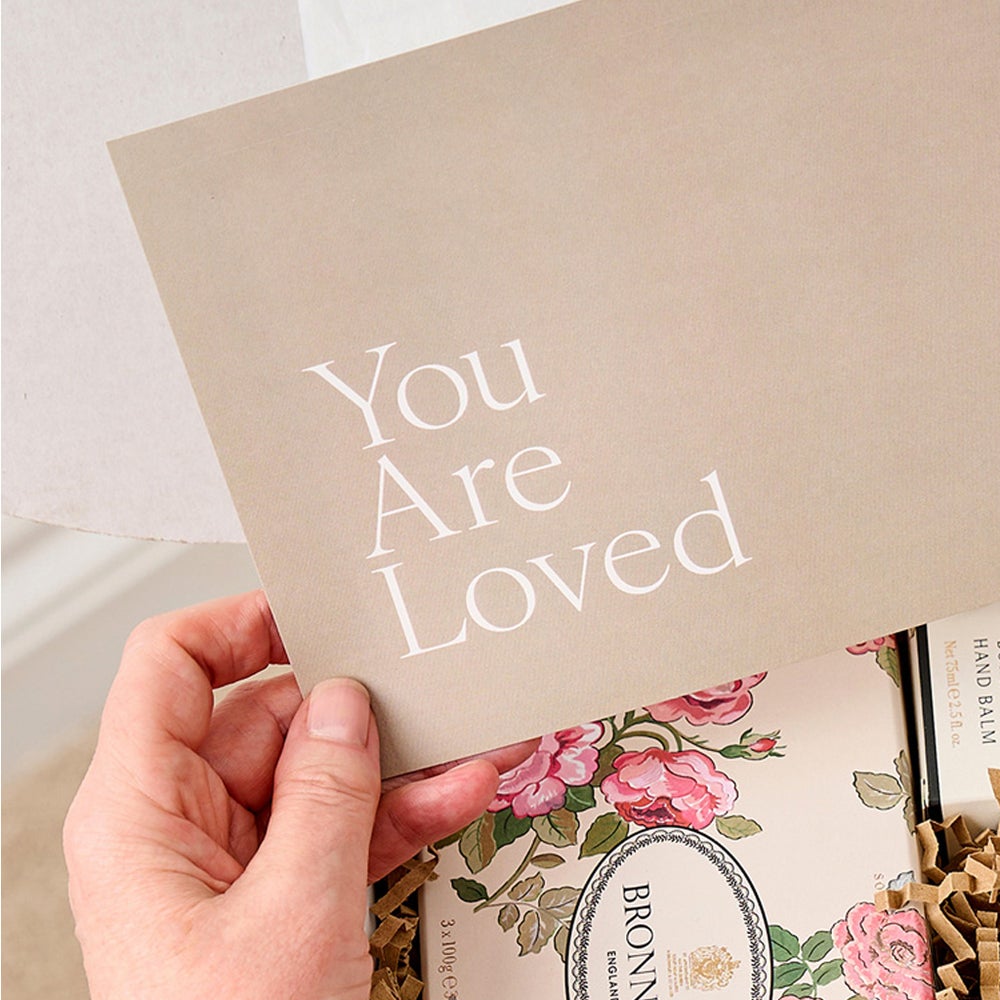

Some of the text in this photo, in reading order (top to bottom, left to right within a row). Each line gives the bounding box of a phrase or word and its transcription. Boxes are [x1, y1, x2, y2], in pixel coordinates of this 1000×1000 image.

[301, 338, 547, 450] You
[365, 446, 572, 559] Are
[372, 469, 753, 659] Loved
[944, 640, 957, 658] Net
[973, 638, 997, 745] HAND BALM
